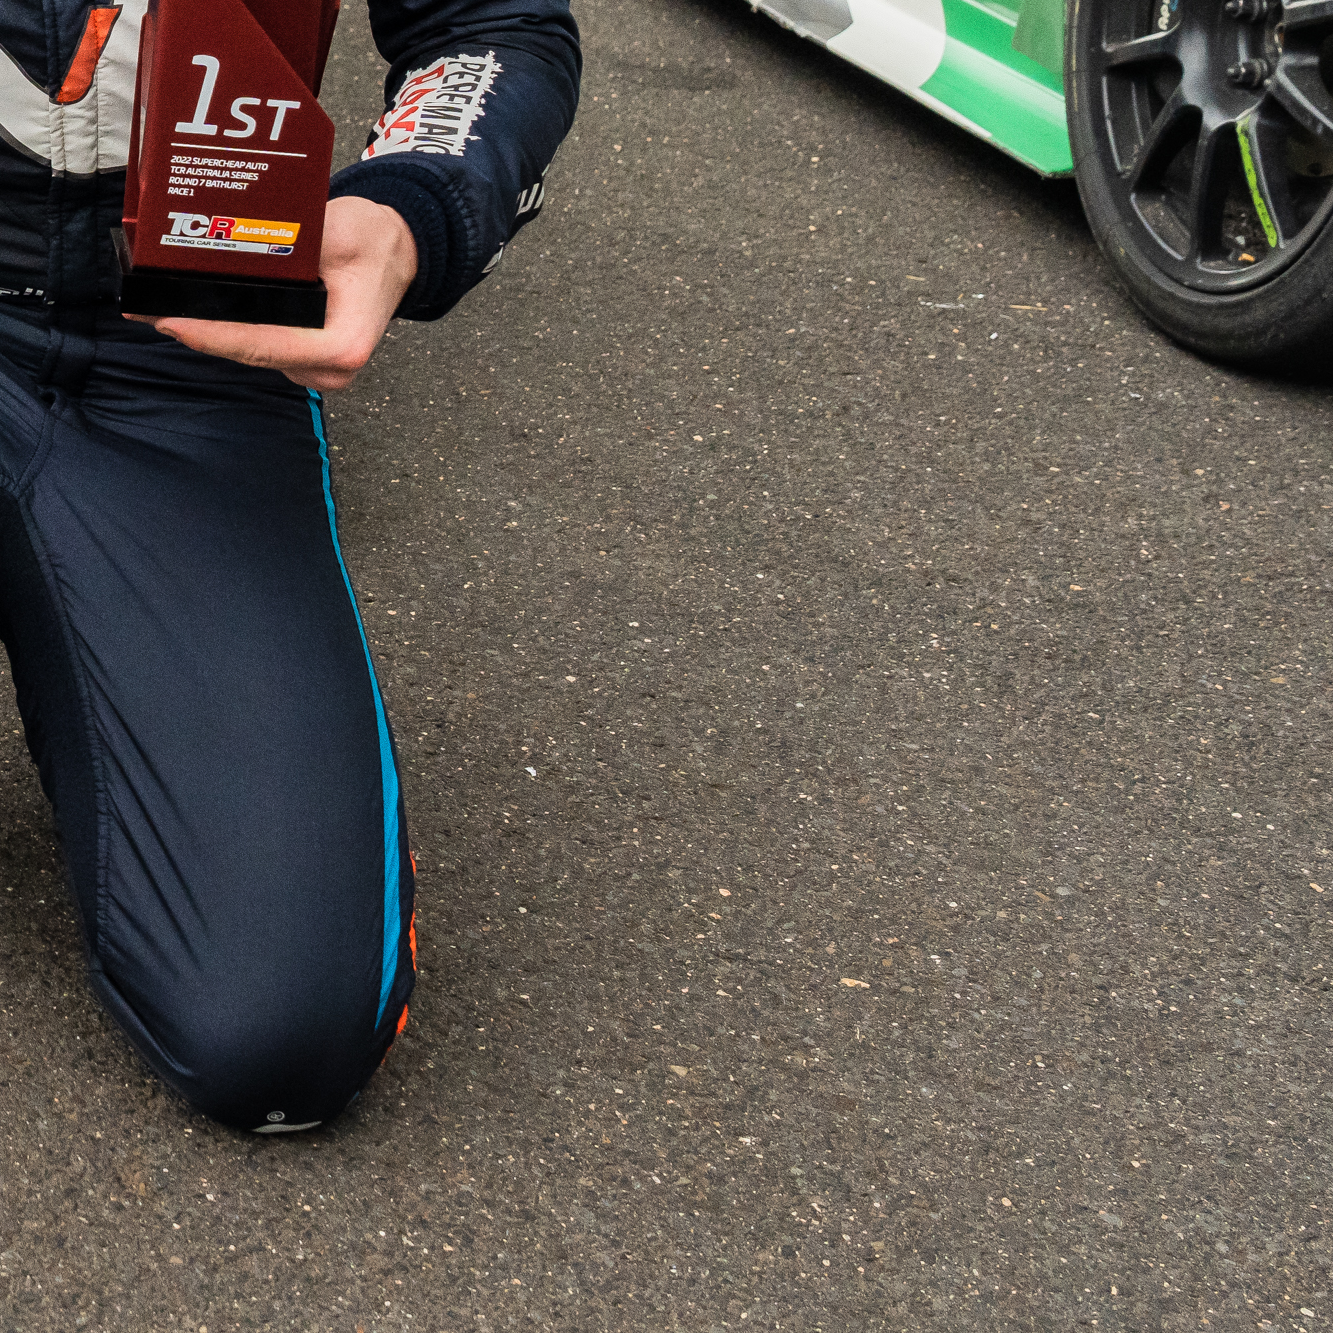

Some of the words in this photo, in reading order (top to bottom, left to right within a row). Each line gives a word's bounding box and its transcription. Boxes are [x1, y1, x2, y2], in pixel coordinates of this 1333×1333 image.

[175, 55, 300, 141] 1ST
[171, 155, 192, 164] 2022
[192, 157, 247, 170] SUPERCHEAP
[248, 162, 269, 171] AUTO
[170, 166, 185, 174] TCR
[186, 166, 229, 178] AUSTRALIA
[231, 171, 259, 181] SERIES
[169, 176, 198, 186] ROUND
[205, 179, 249, 190] BATHURST
[167, 187, 188, 196] RACE
[168, 211, 236, 239] TCR
[235, 225, 294, 238] Australia
[165, 237, 195, 245] TOURING
